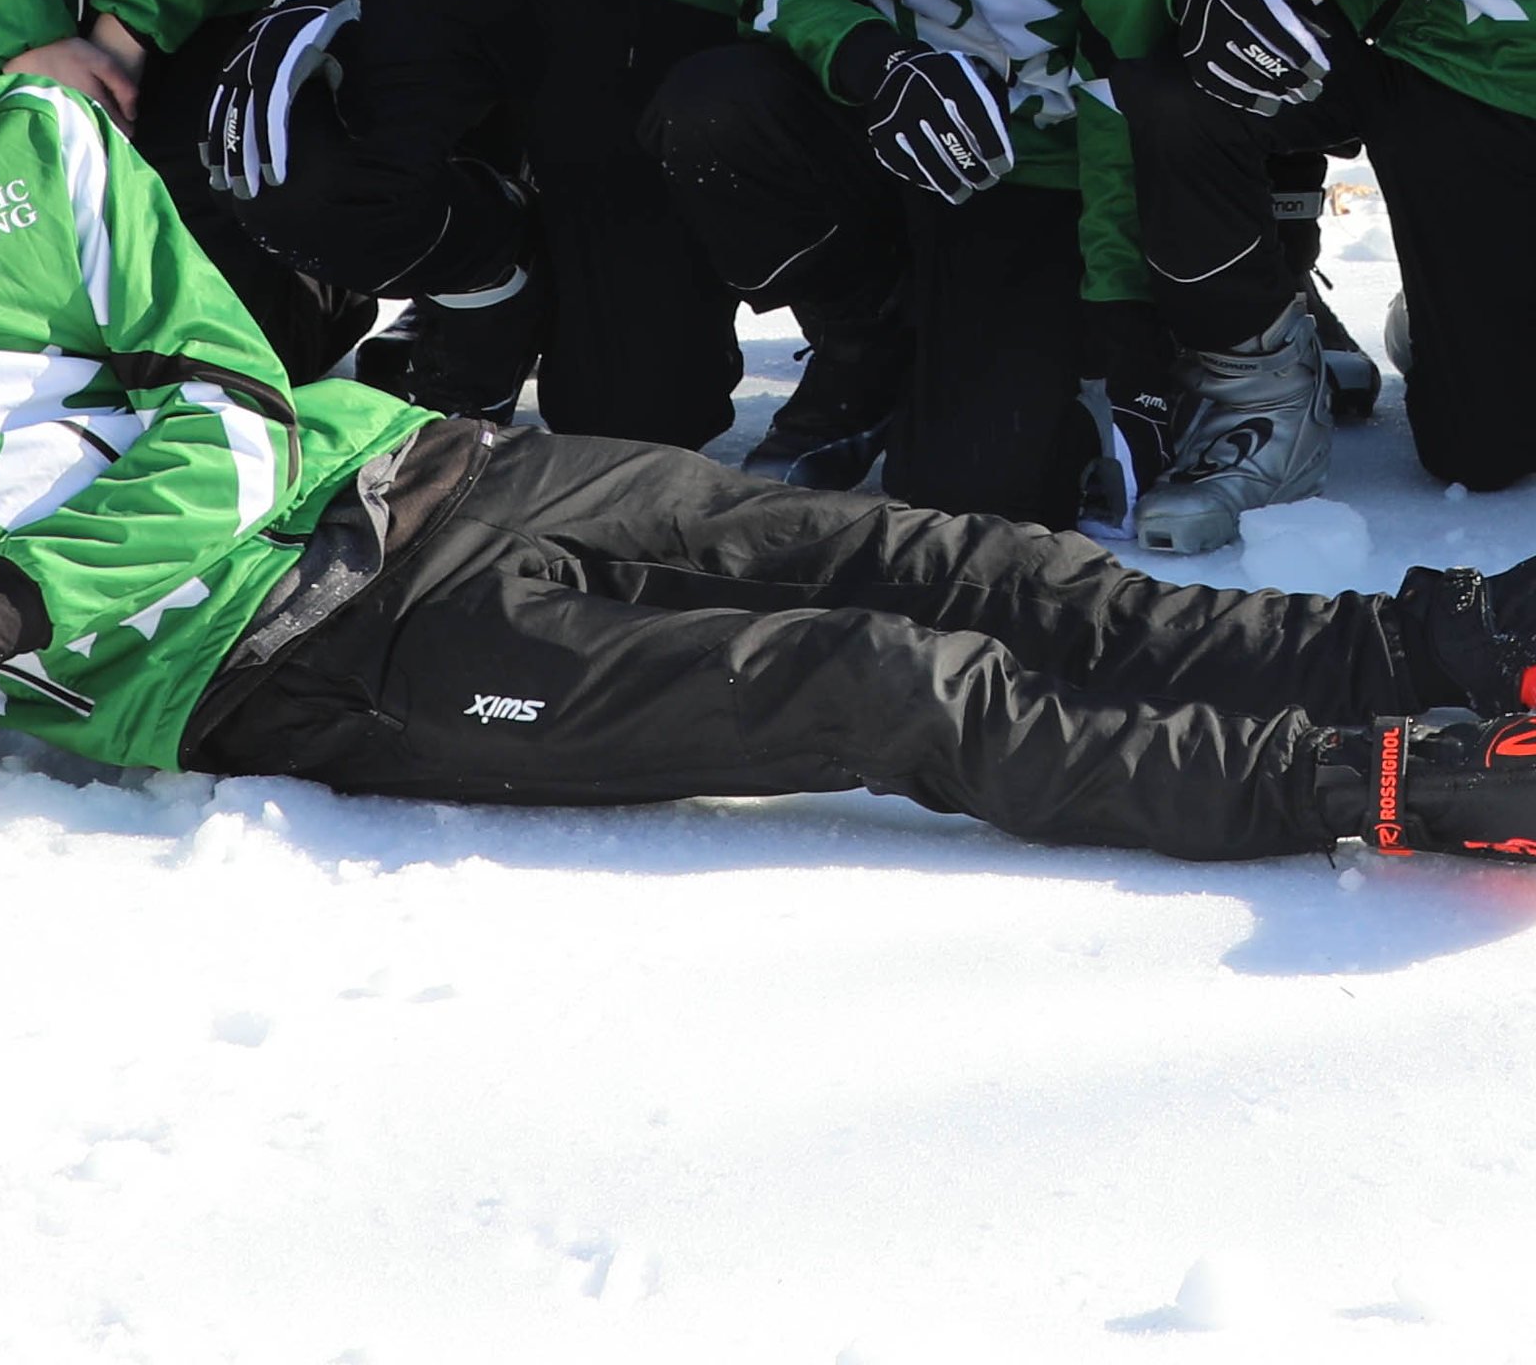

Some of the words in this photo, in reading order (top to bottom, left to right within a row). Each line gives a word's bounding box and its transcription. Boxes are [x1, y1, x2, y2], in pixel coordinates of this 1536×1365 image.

[1241, 41, 1289, 77] swix
[940, 131, 976, 170] swix
[465, 694, 545, 724] swix
